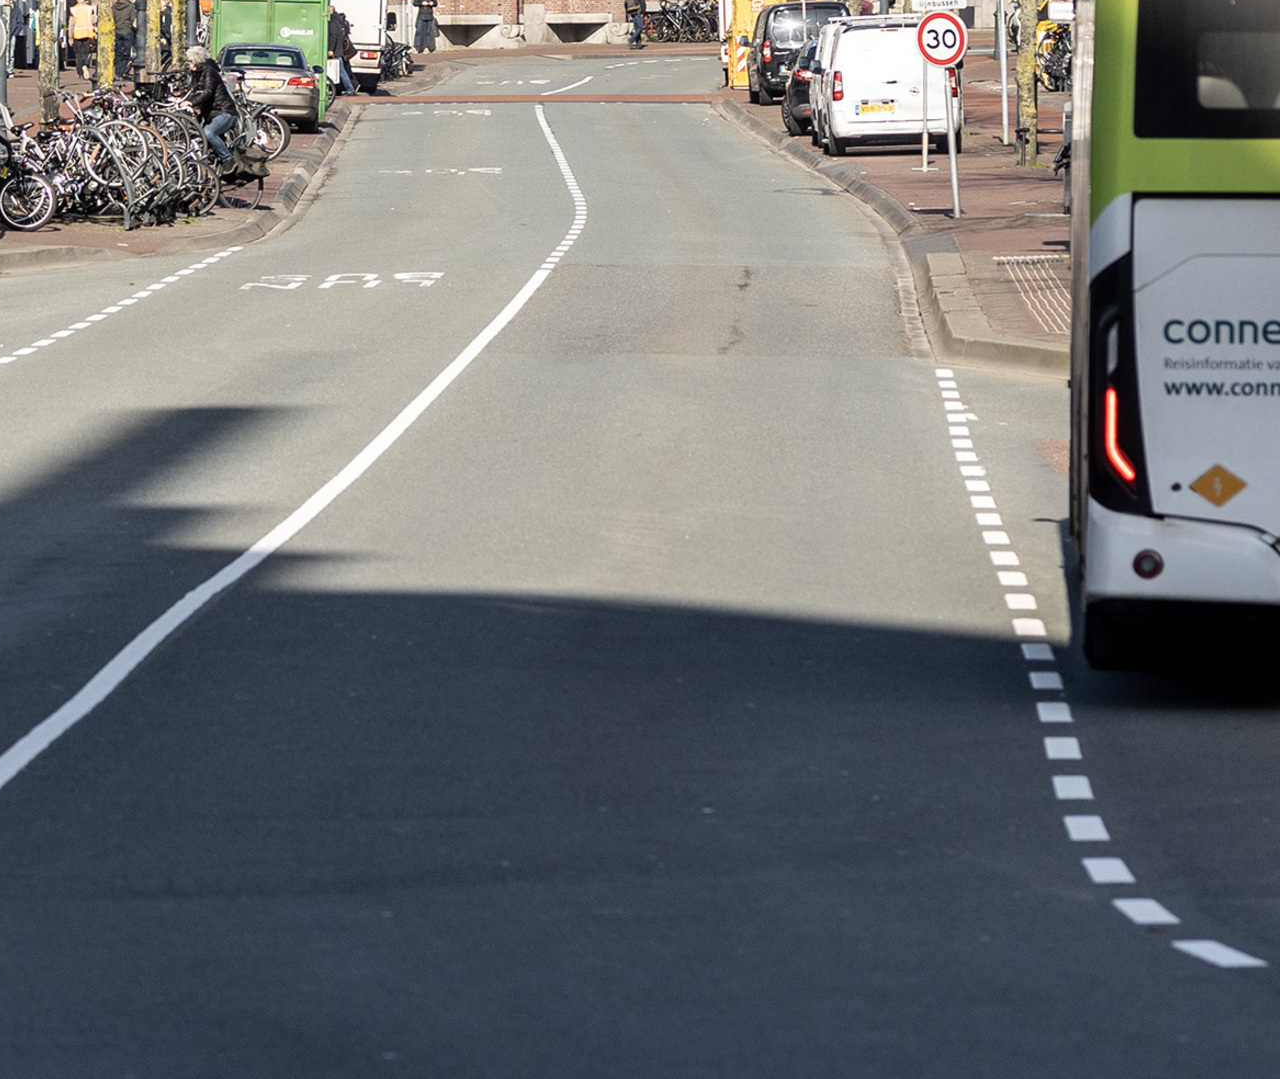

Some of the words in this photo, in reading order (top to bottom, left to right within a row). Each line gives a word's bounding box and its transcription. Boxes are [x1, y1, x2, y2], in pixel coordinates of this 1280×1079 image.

[919, 0, 959, 10] lijnbussen
[926, 29, 957, 49] 30
[1163, 357, 1265, 371] Reisinformatie
